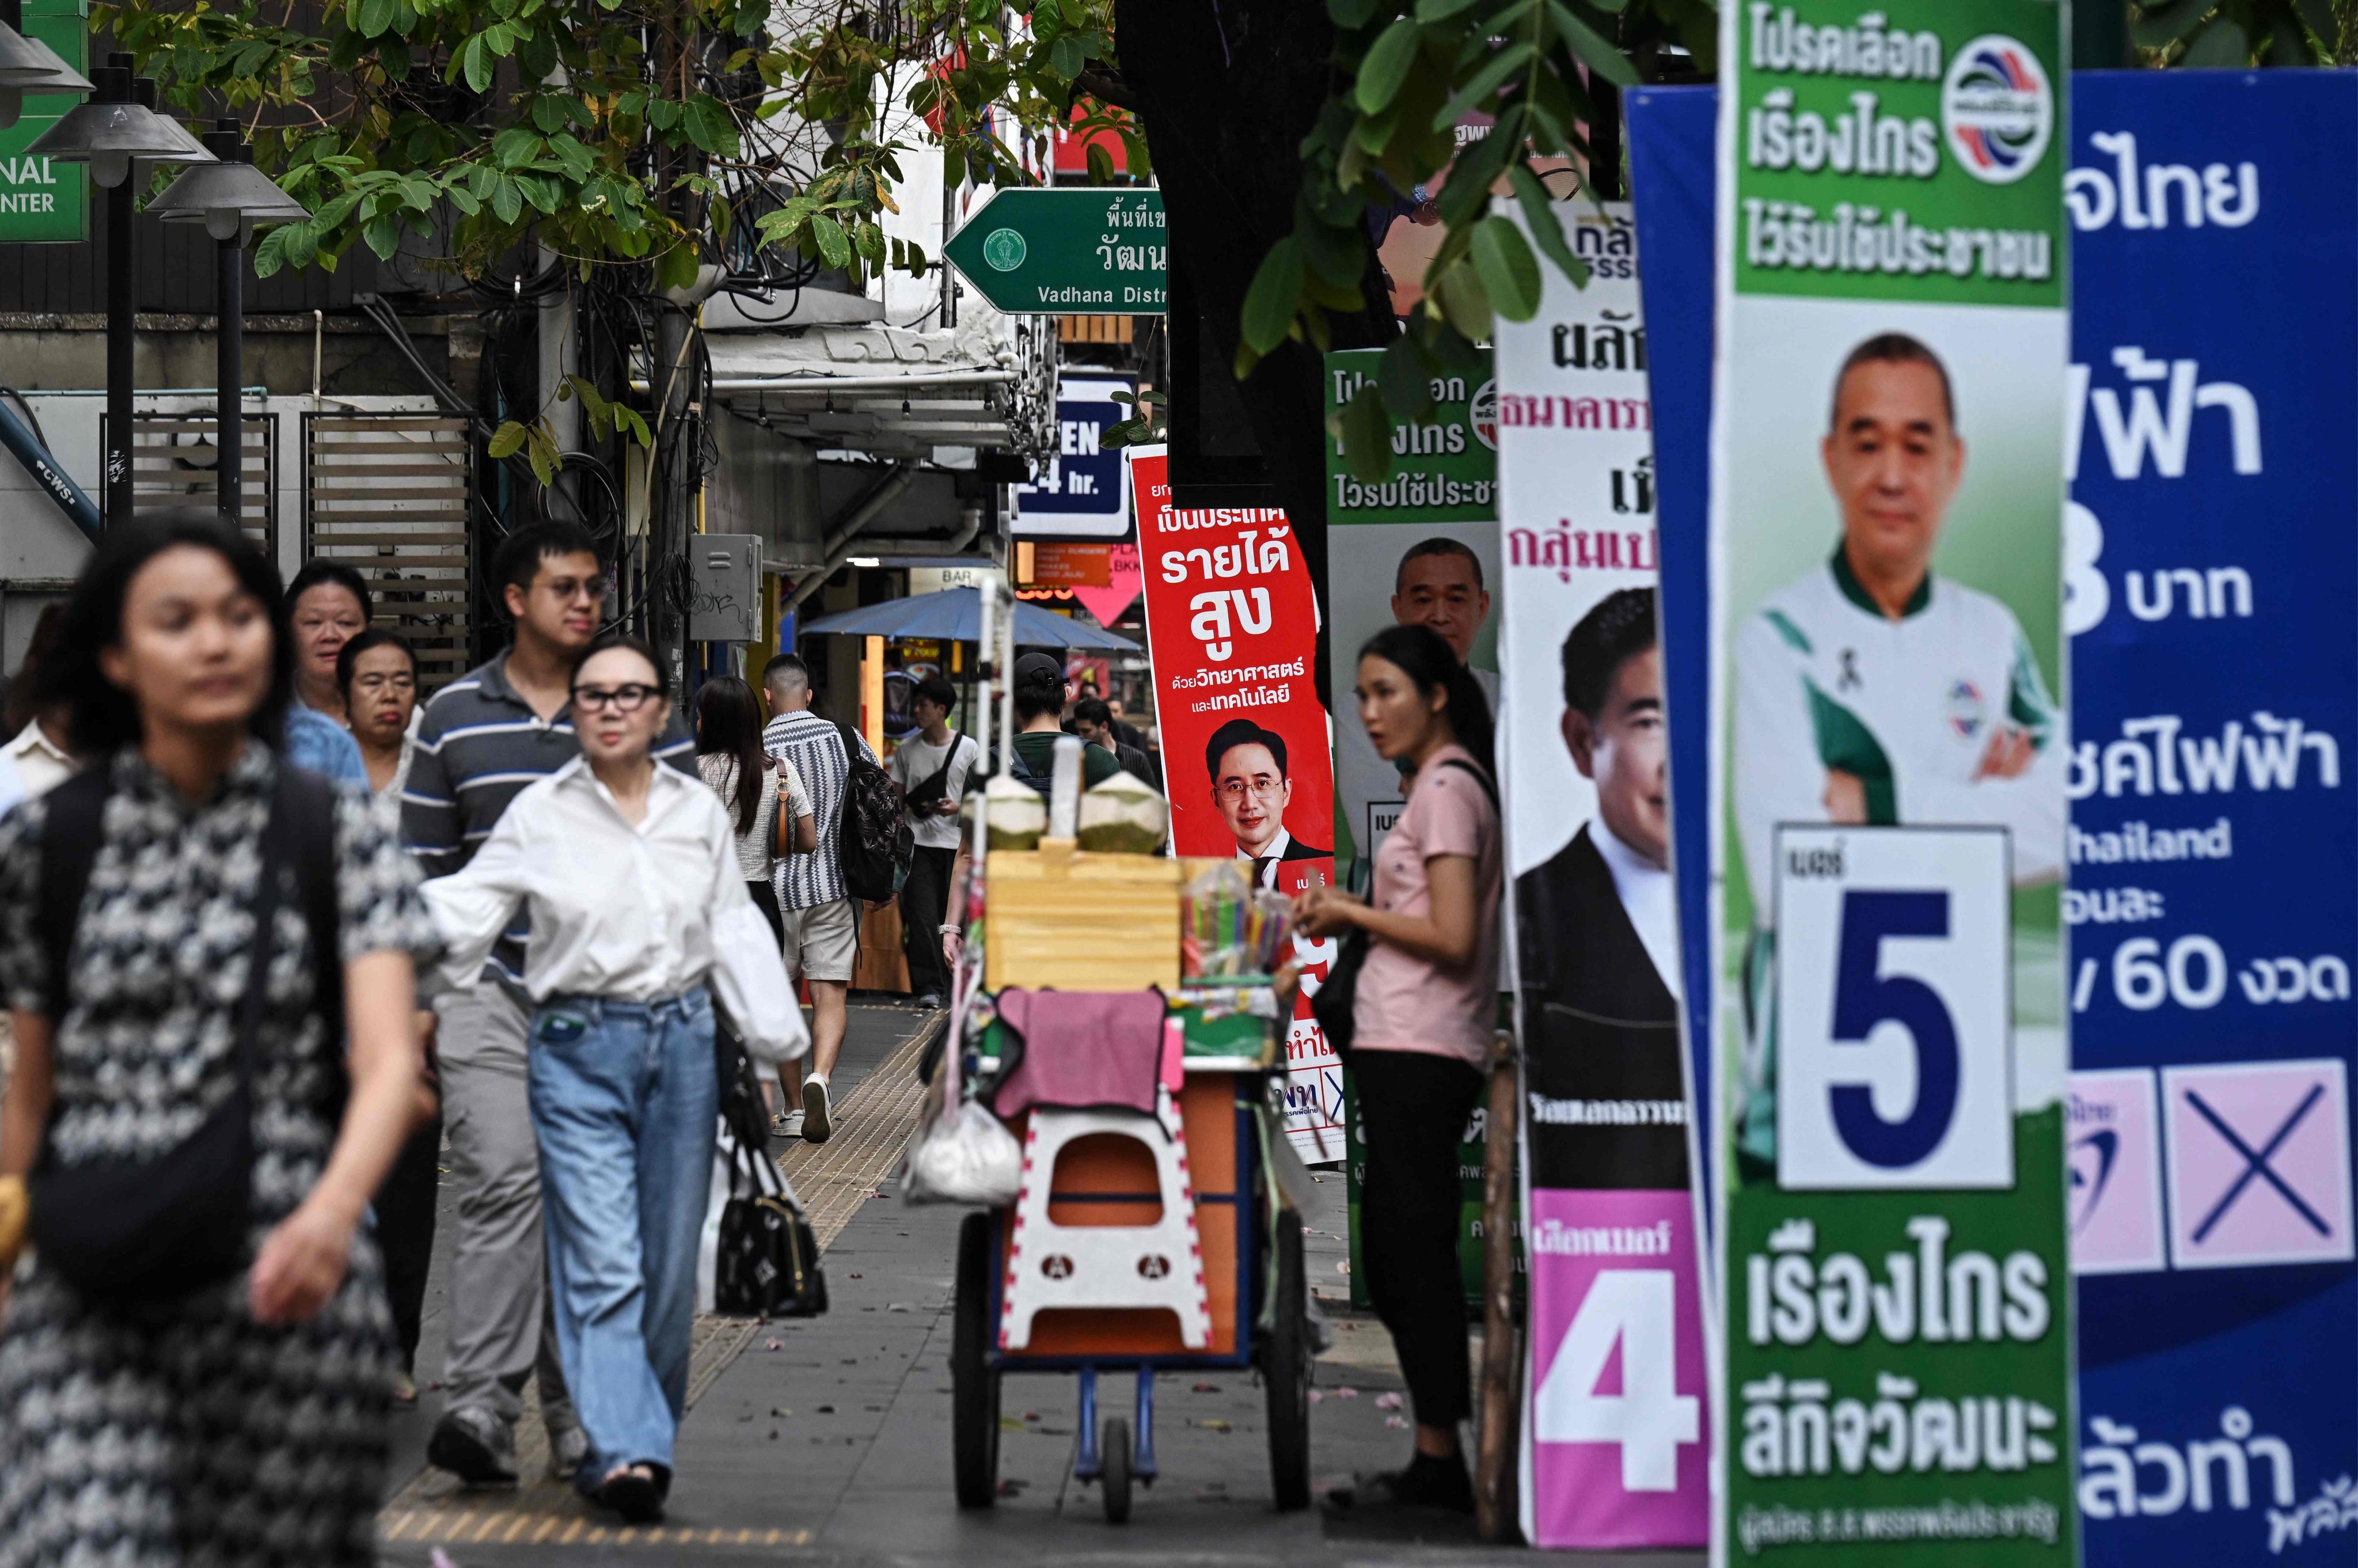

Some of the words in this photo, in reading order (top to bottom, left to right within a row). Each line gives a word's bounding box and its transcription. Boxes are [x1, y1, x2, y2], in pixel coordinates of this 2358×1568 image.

[1107, 196, 1165, 227] พื้นที่เข
[1096, 234, 1166, 271] วัฒน
[1038, 287, 1112, 303] Vadhana
[1125, 287, 1166, 303] Distr
[1061, 421, 1100, 455] EN
[43, 468, 71, 500] CWS
[1069, 470, 1099, 495] hr.
[1151, 485, 1171, 497] ยก
[1161, 526, 1289, 583] รายได้
[1508, 518, 1656, 583] กลุ่มเป
[943, 570, 971, 583] BAR
[2125, 566, 2253, 621] บาท
[1190, 587, 1273, 662] สูง
[1172, 656, 1304, 690] ด้วยวิทยาศาสตร์
[1192, 685, 1290, 713] และเทคโนโลยี
[2070, 818, 2232, 863] hailand
[1297, 873, 1325, 890] เบร์
[2112, 933, 2227, 1010] 60
[2238, 954, 2350, 1005] งวด
[1827, 890, 1962, 1171] 5
[1284, 1107, 1318, 1117] รรคเพื่อไทย
[1535, 1270, 1700, 1492] 4
